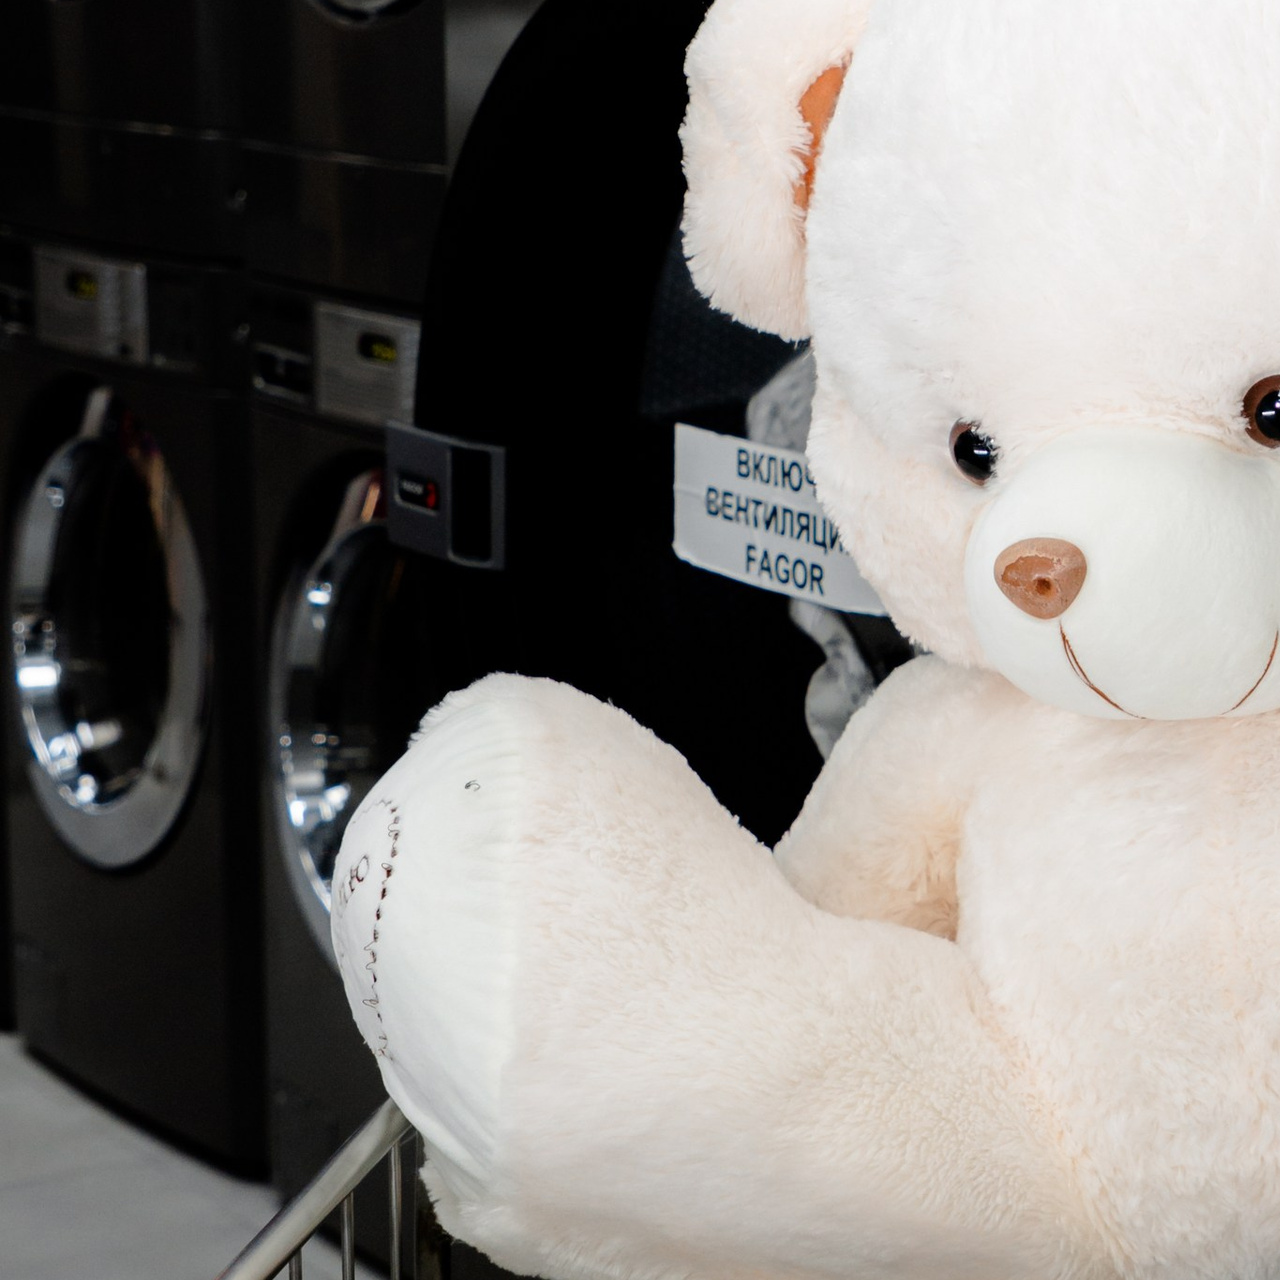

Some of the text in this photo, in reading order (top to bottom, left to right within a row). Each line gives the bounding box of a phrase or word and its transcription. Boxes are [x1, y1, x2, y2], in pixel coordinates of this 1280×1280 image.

[736, 448, 816, 496] ВКЛЮЧ
[705, 487, 849, 555] ВЕНТИЛЯЦИ
[745, 544, 825, 595] FAGOR
